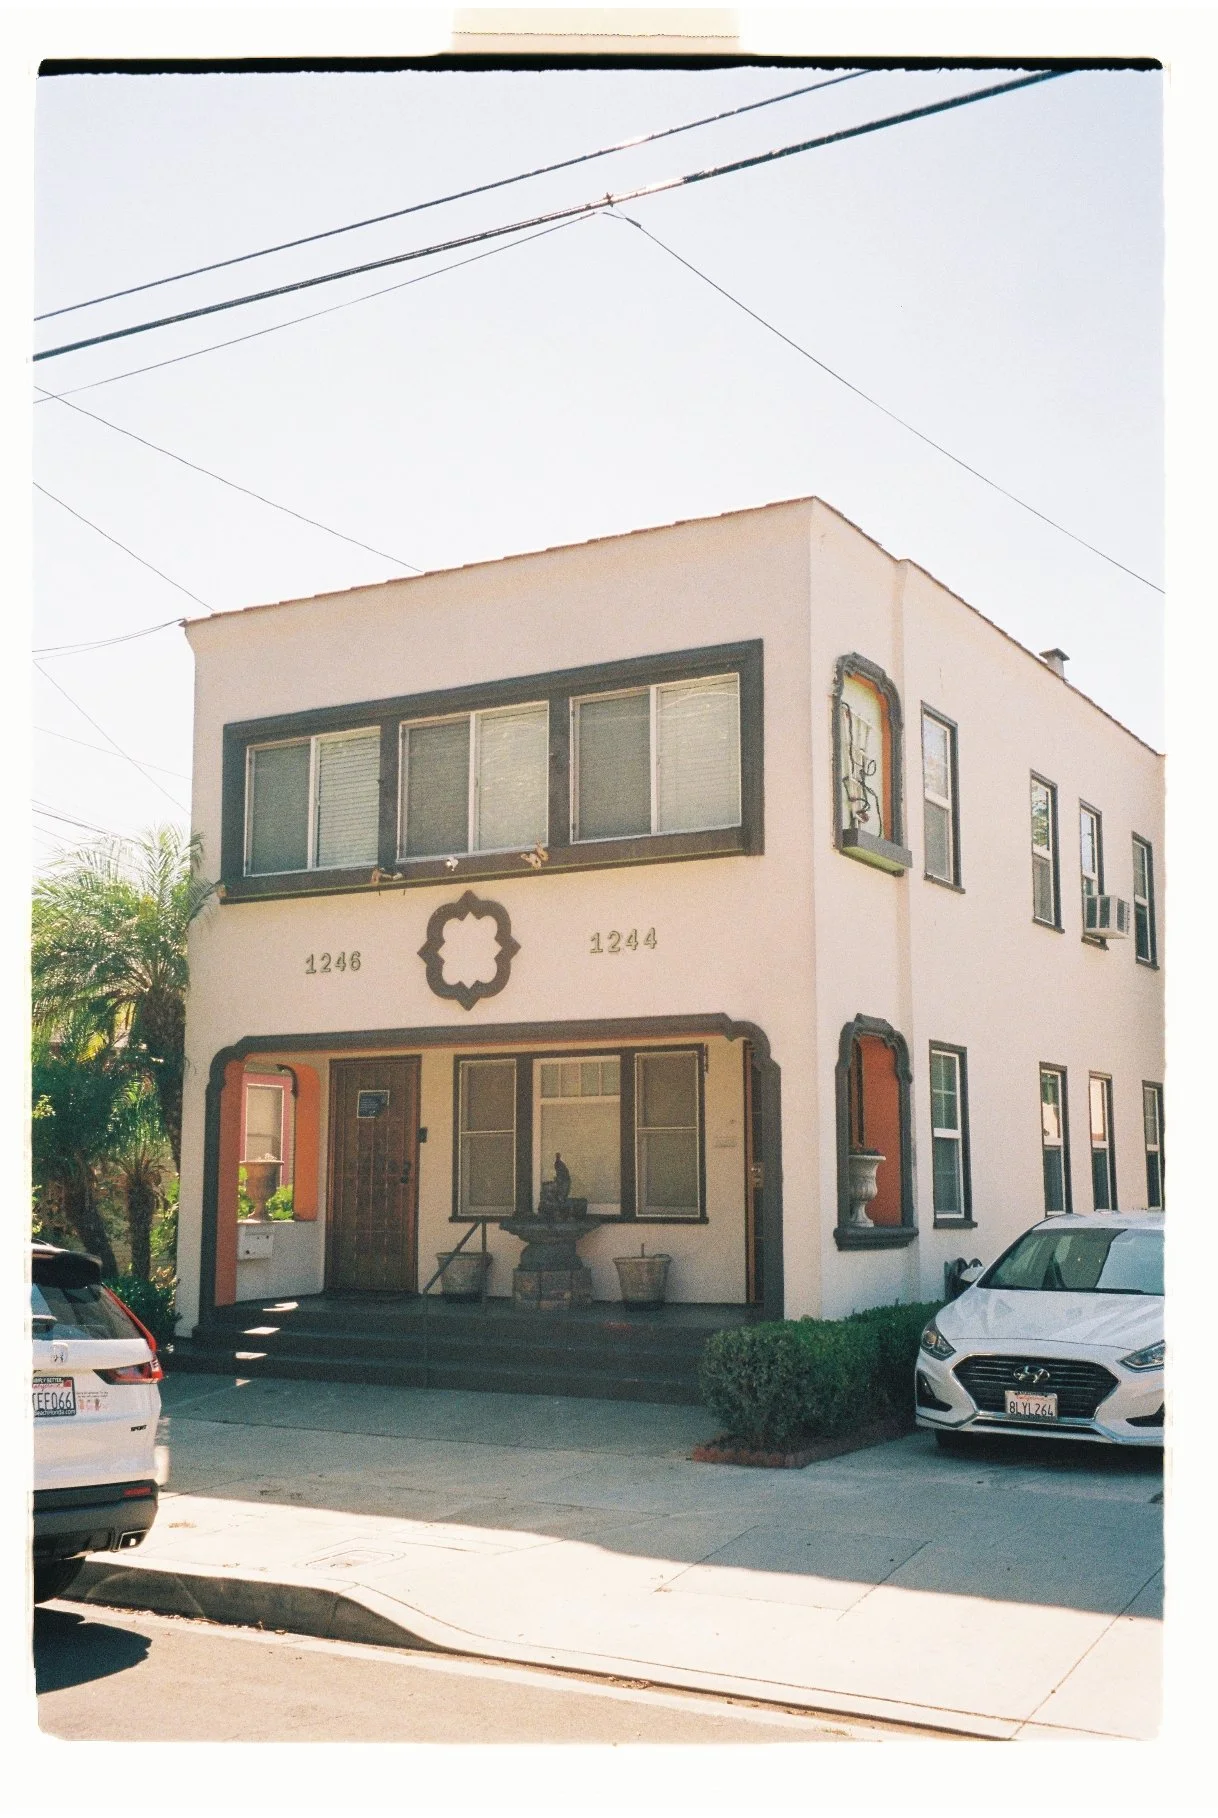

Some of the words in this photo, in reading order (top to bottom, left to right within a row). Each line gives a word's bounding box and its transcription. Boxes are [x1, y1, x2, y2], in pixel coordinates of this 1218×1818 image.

[589, 927, 657, 954] 1244
[305, 950, 361, 974] 1246
[1009, 1401, 1054, 1416] 8LYL264
